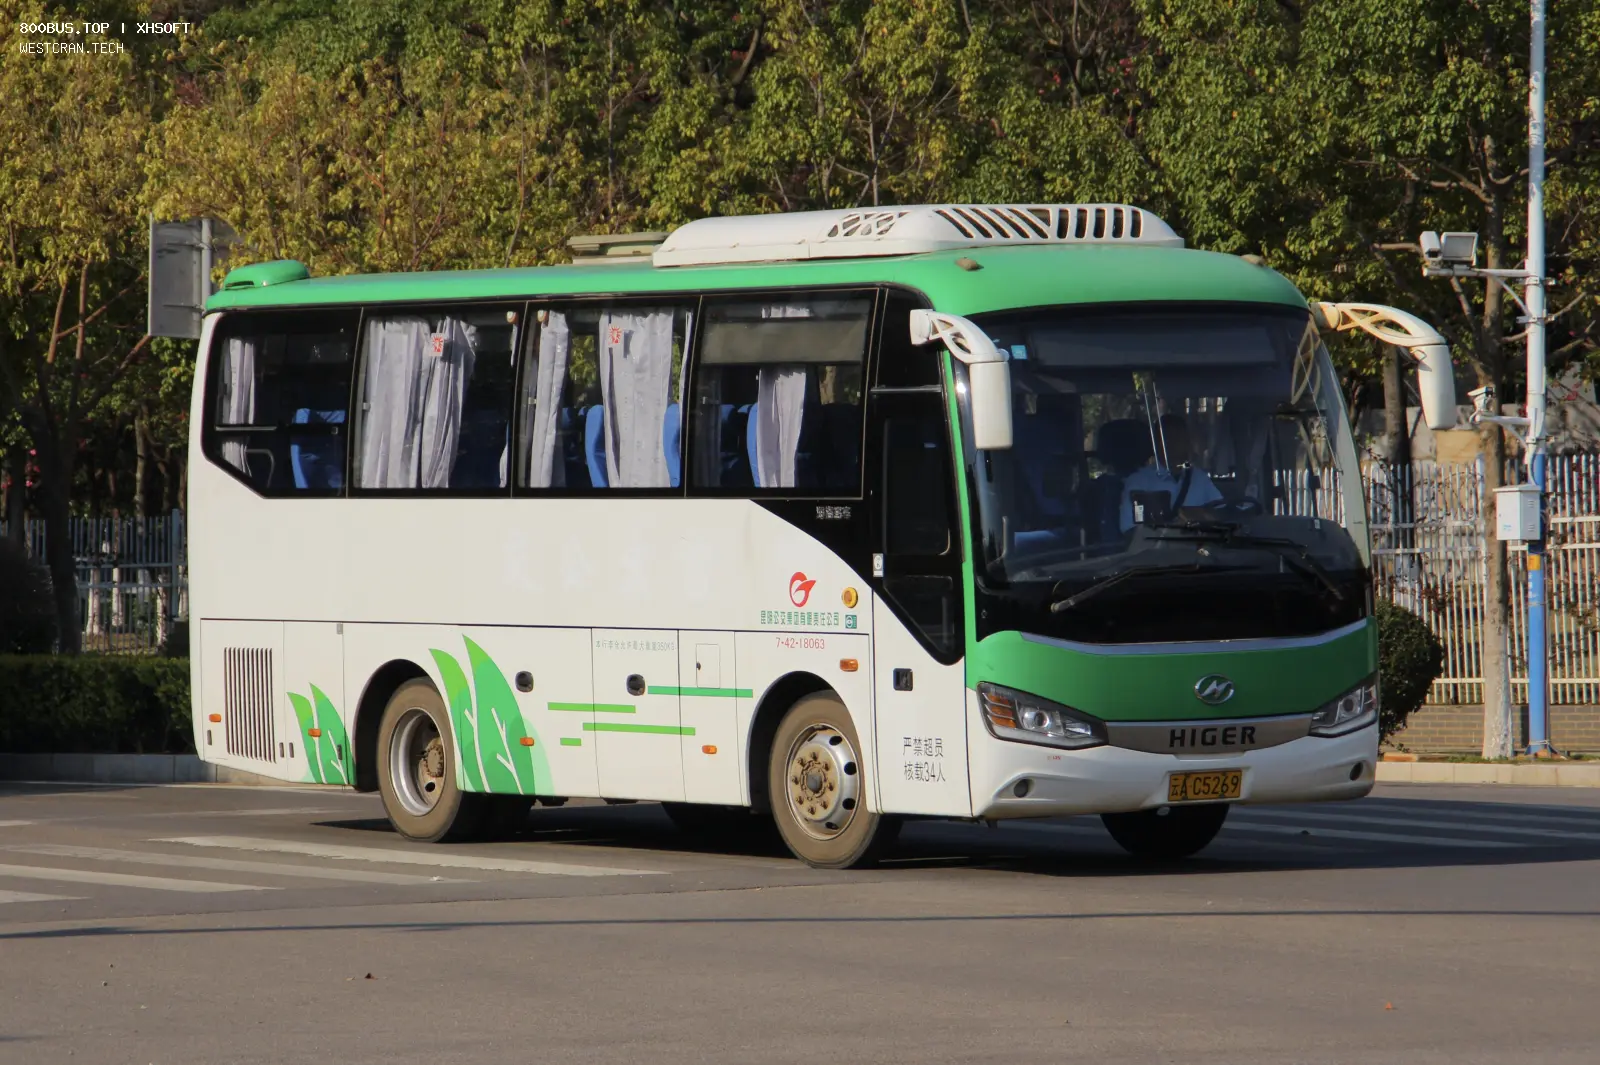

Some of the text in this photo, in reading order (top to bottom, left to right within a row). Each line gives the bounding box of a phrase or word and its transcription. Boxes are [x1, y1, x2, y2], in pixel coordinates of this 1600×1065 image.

[902, 737, 944, 758] 严禁超员
[1169, 726, 1256, 748] HIGER
[904, 761, 946, 782] 核载34人
